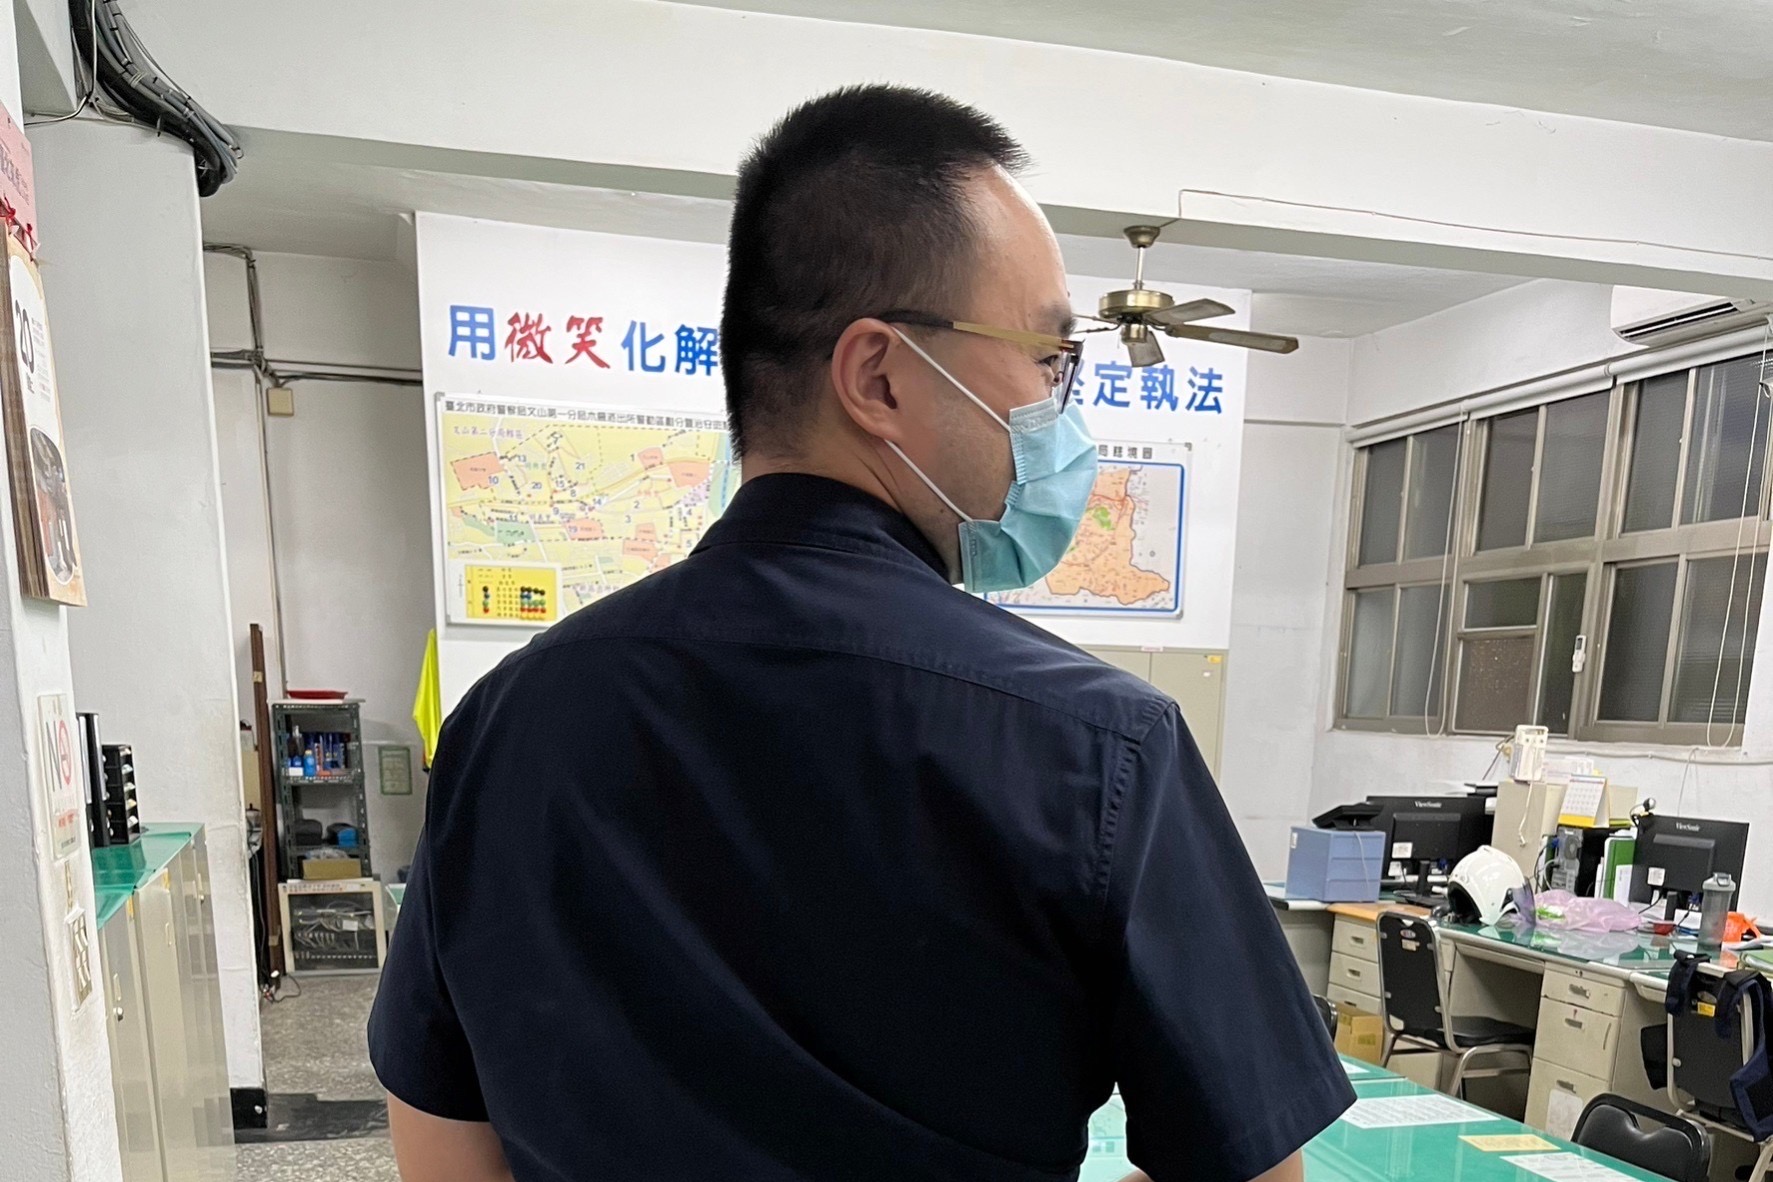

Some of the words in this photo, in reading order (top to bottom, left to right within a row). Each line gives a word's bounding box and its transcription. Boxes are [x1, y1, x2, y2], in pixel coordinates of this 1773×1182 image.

[448, 305, 718, 376] 用微笑化解
